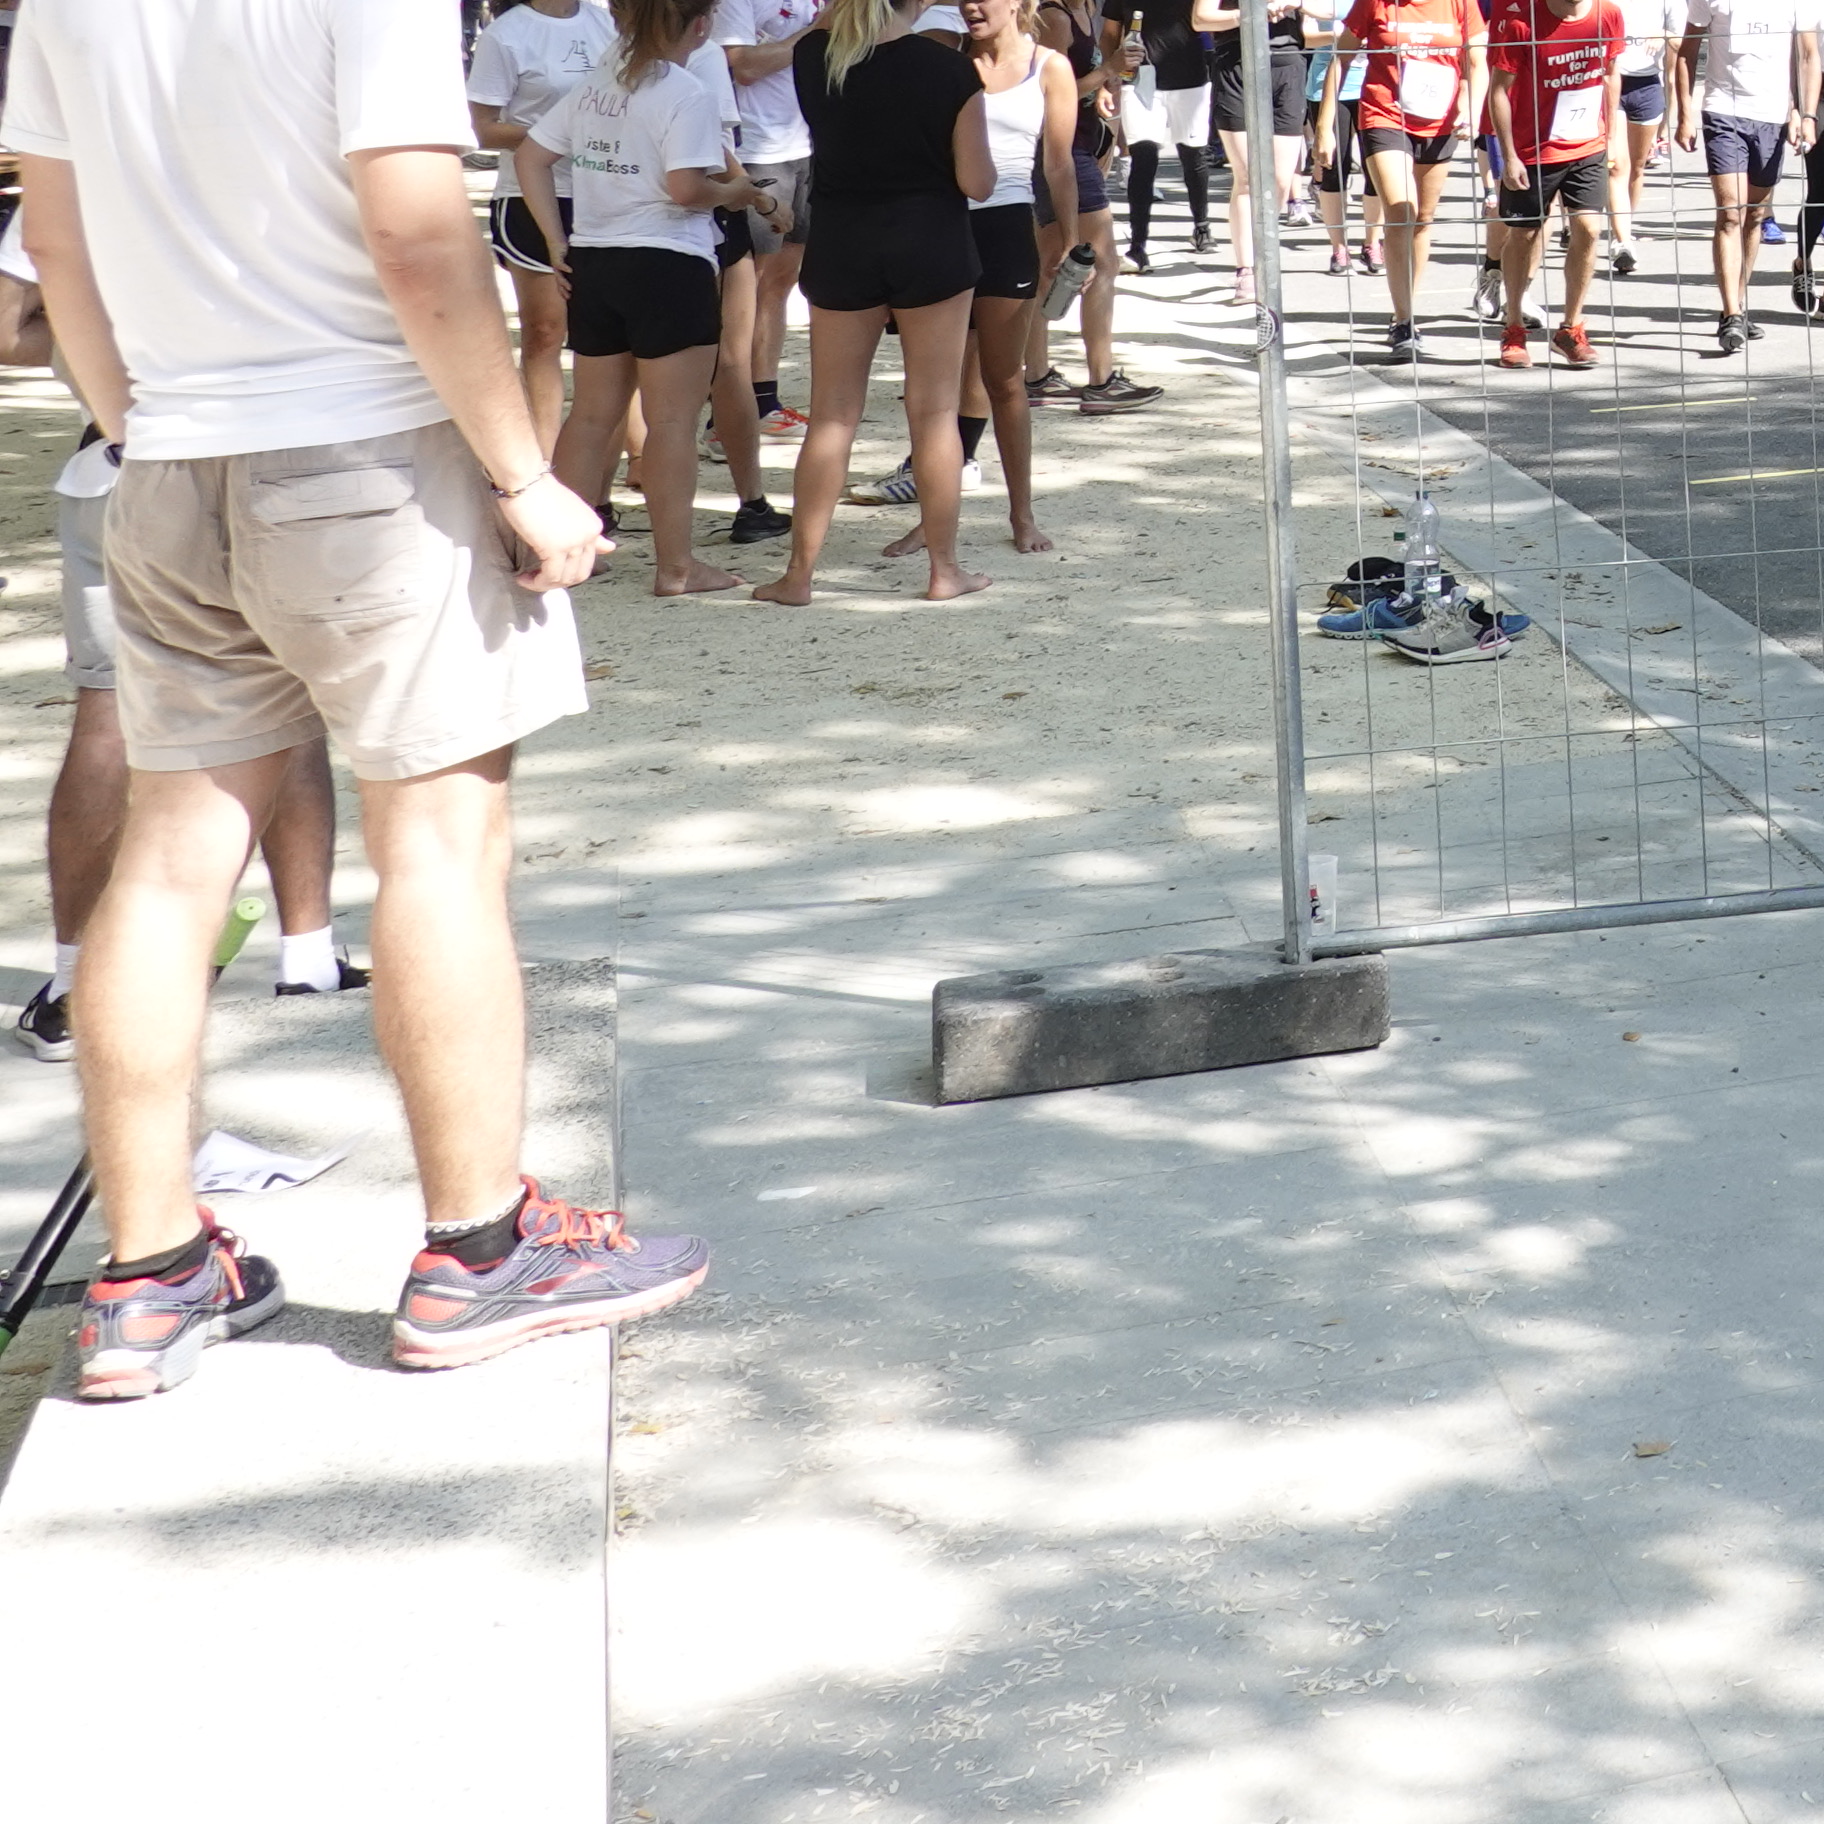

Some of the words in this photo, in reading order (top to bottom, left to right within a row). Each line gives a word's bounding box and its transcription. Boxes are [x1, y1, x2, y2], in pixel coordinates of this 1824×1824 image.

[1547, 44, 1607, 66] running
[1569, 60, 1589, 72] for
[1543, 67, 1607, 89] refugees
[578, 86, 631, 117] PAULA
[1570, 108, 1586, 122] 77
